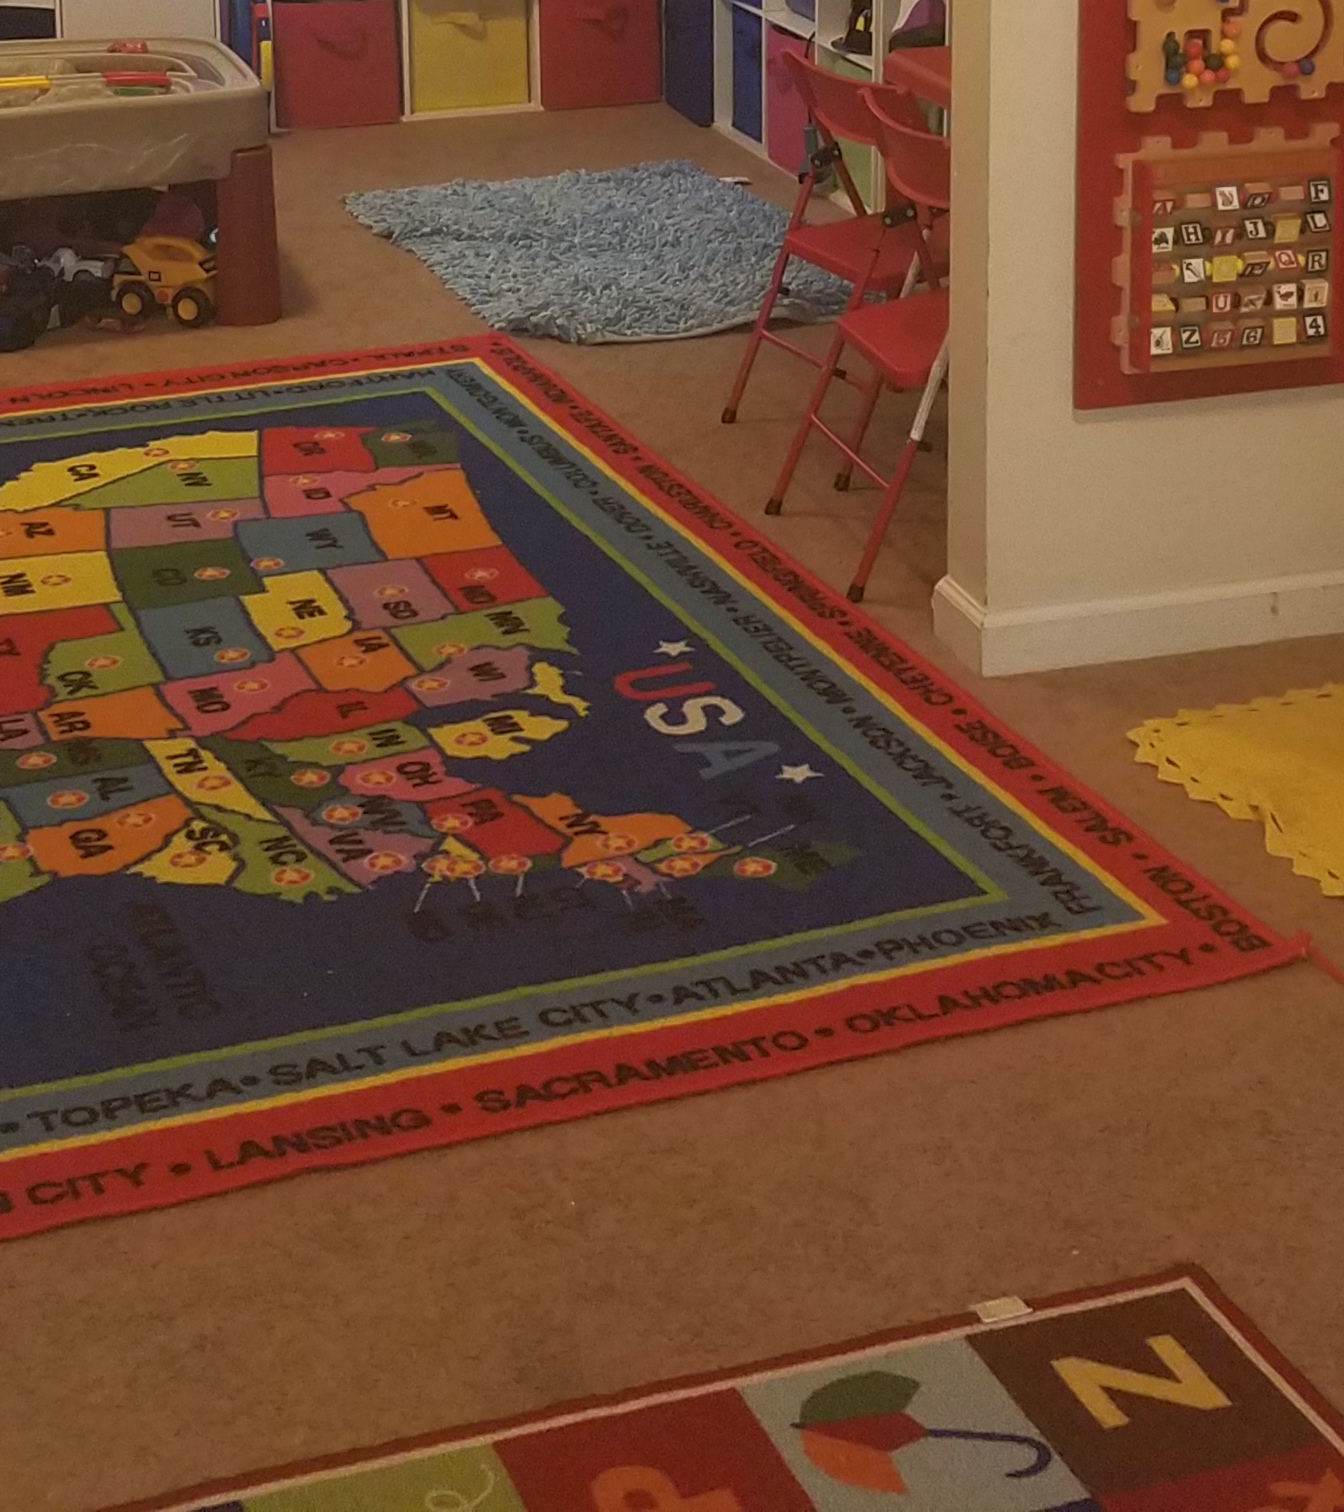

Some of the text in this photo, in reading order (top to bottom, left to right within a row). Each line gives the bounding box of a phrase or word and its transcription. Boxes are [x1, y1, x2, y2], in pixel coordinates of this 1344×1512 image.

[1313, 182, 1325, 201] F
[1184, 225, 1201, 242] H
[1248, 220, 1260, 237] J
[1310, 253, 1326, 271] R
[1215, 293, 1230, 310] U
[1182, 329, 1199, 346] Z
[1309, 318, 1322, 335] 4
[62, 462, 104, 482] CA
[17, 518, 57, 540] AZ
[163, 511, 204, 531] UT
[301, 527, 347, 552] WY
[285, 596, 329, 620] NE
[181, 625, 226, 649] KS
[464, 661, 508, 683] WI
[48, 708, 96, 736] AR
[612, 661, 781, 782] USA
[364, 728, 409, 750] IN
[839, 713, 960, 793] JACKSON
[162, 746, 210, 776] TN
[392, 758, 445, 789] OH
[91, 773, 138, 801] AL
[556, 810, 610, 841] NY
[65, 825, 119, 860] GA
[180, 823, 234, 859] SC
[255, 833, 308, 869] NC
[324, 831, 377, 864] VA
[945, 801, 1107, 917] FRANKFORT
[1134, 862, 1277, 955] BOSTON
[24, 1069, 249, 1140] TOPEKA
[261, 1041, 396, 1090] SALT
[395, 1014, 533, 1062] LAKE
[530, 989, 654, 1034] CITY
[657, 947, 872, 1008] ATLANTA
[868, 907, 1068, 964] PHOENIX
[21, 1156, 160, 1211] CITY
[198, 1101, 439, 1175] LANSING
[467, 1023, 819, 1120] SACRAMENTO
